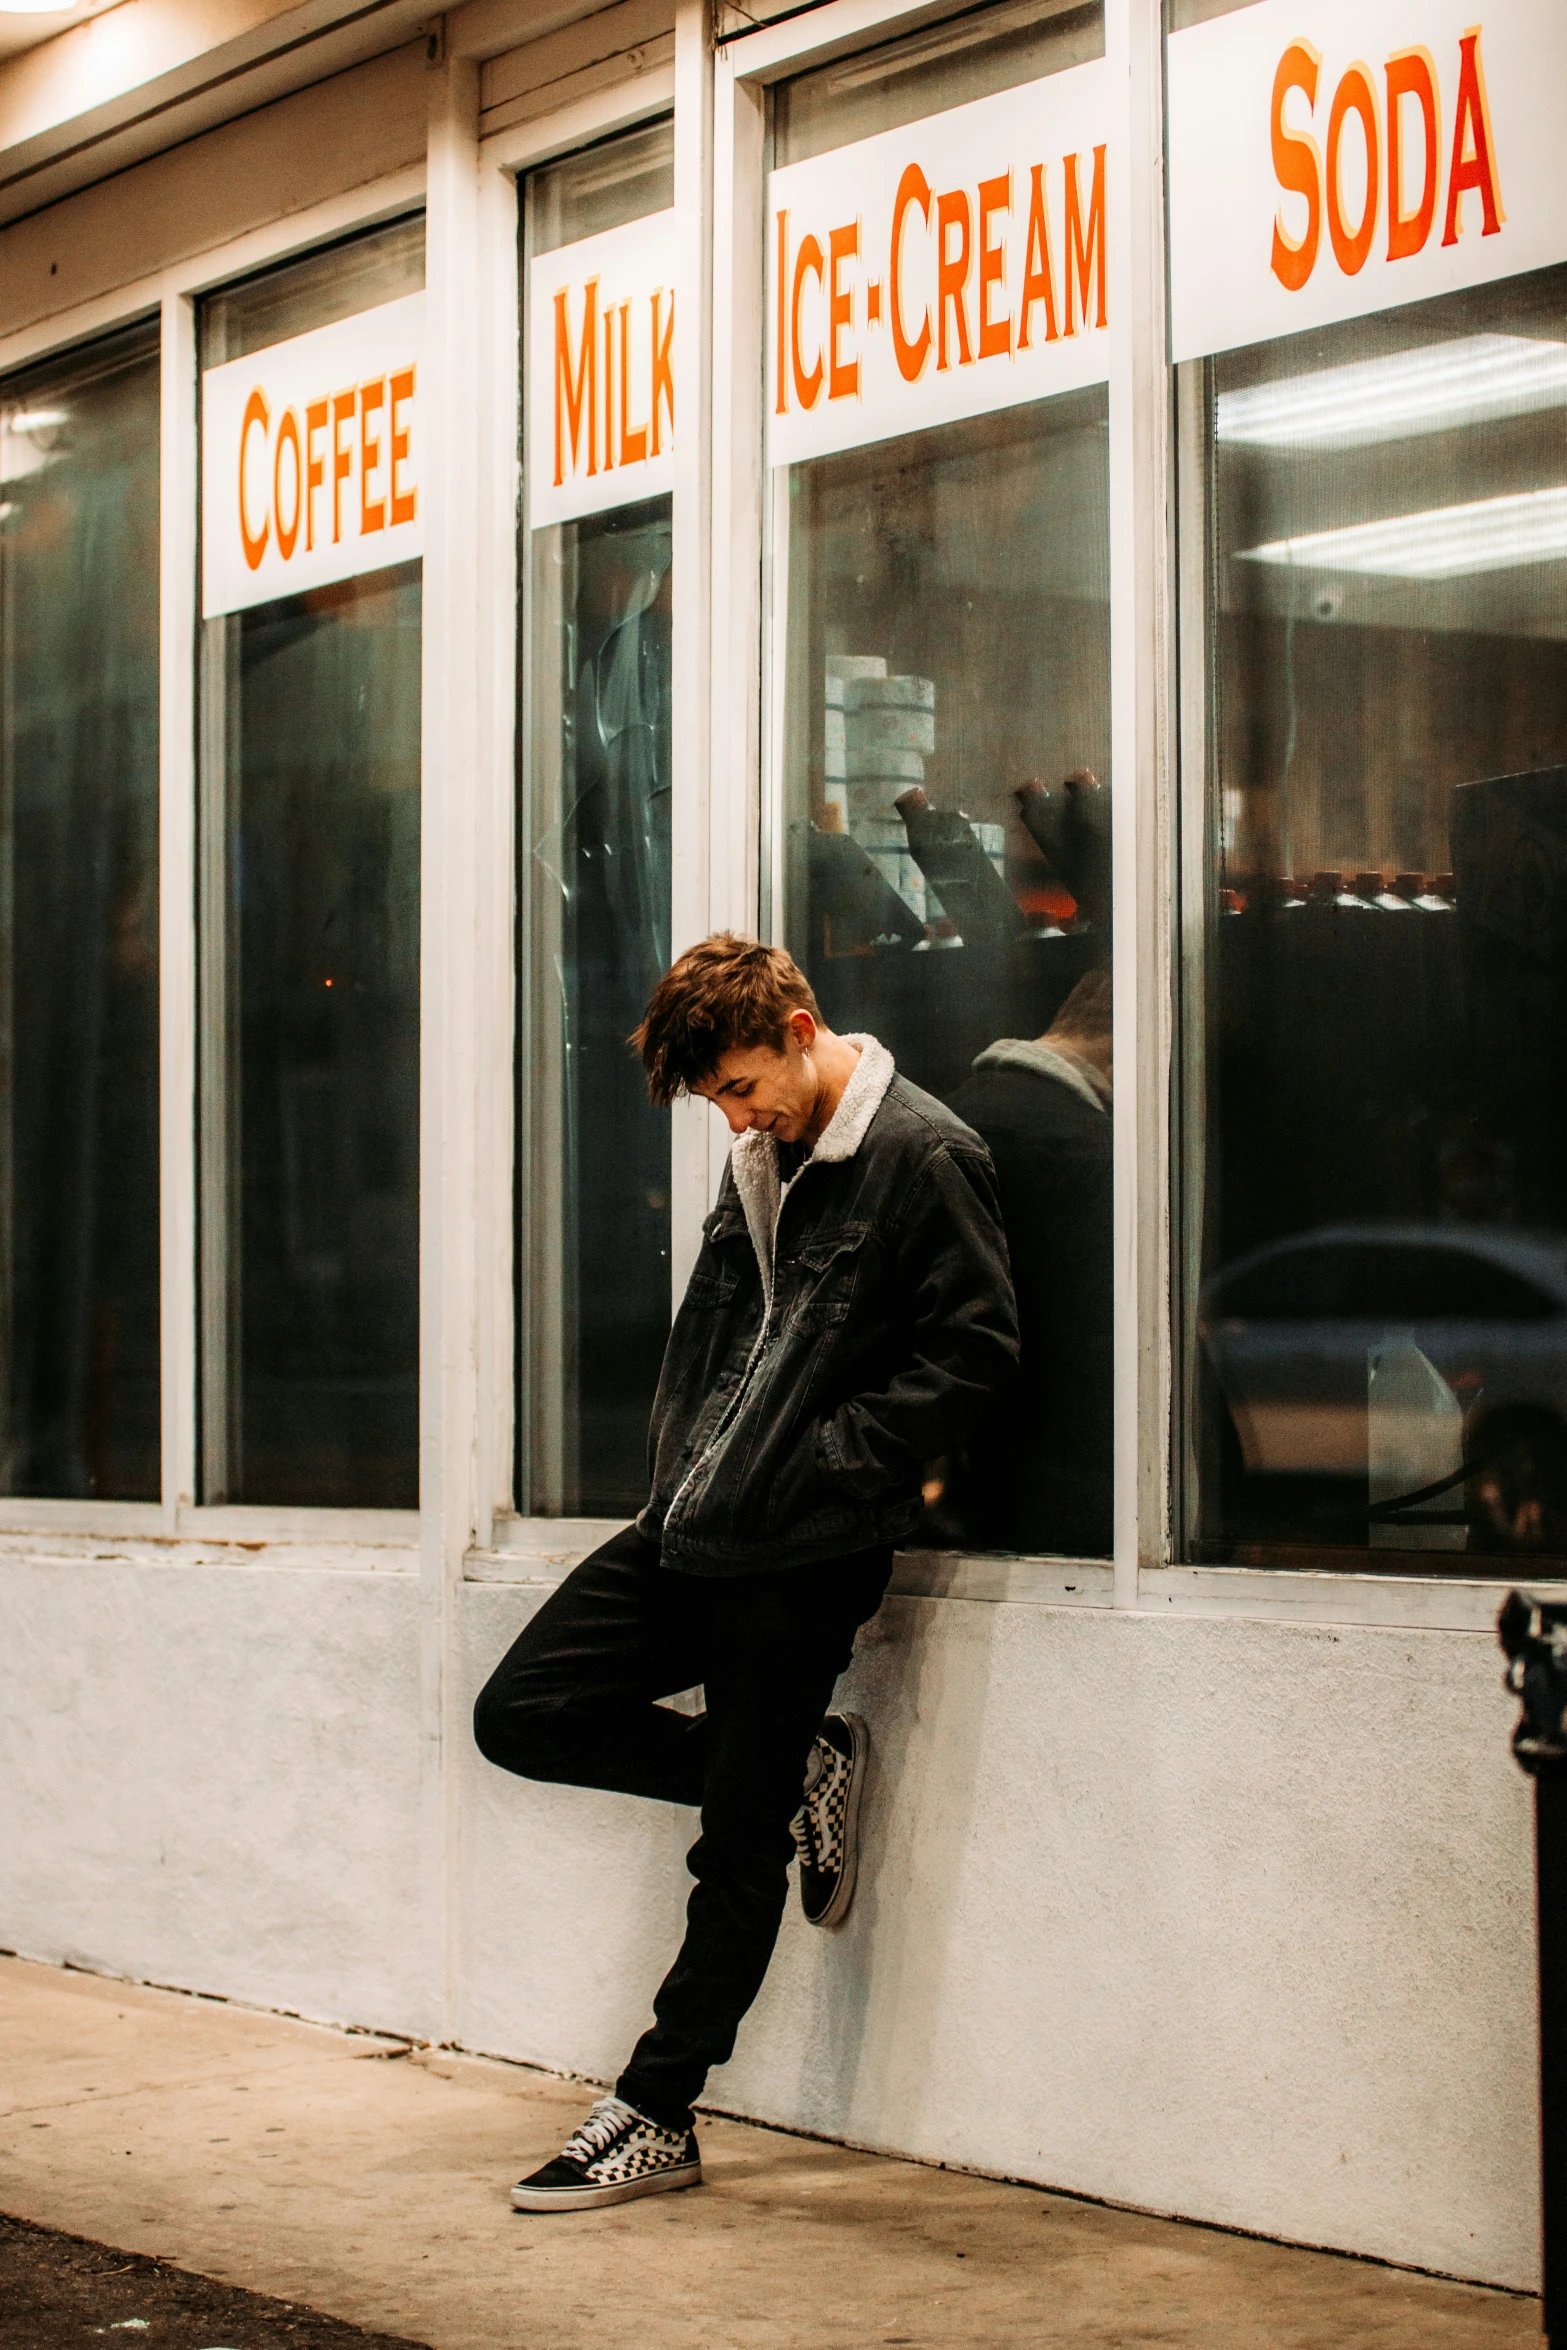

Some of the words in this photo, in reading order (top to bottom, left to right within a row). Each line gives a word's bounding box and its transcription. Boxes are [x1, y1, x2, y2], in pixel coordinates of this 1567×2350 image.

[1270, 24, 1508, 292] SODA
[553, 273, 675, 488] MILK
[774, 143, 1109, 417] ICE-CREAM
[238, 363, 418, 572] COFFEE
